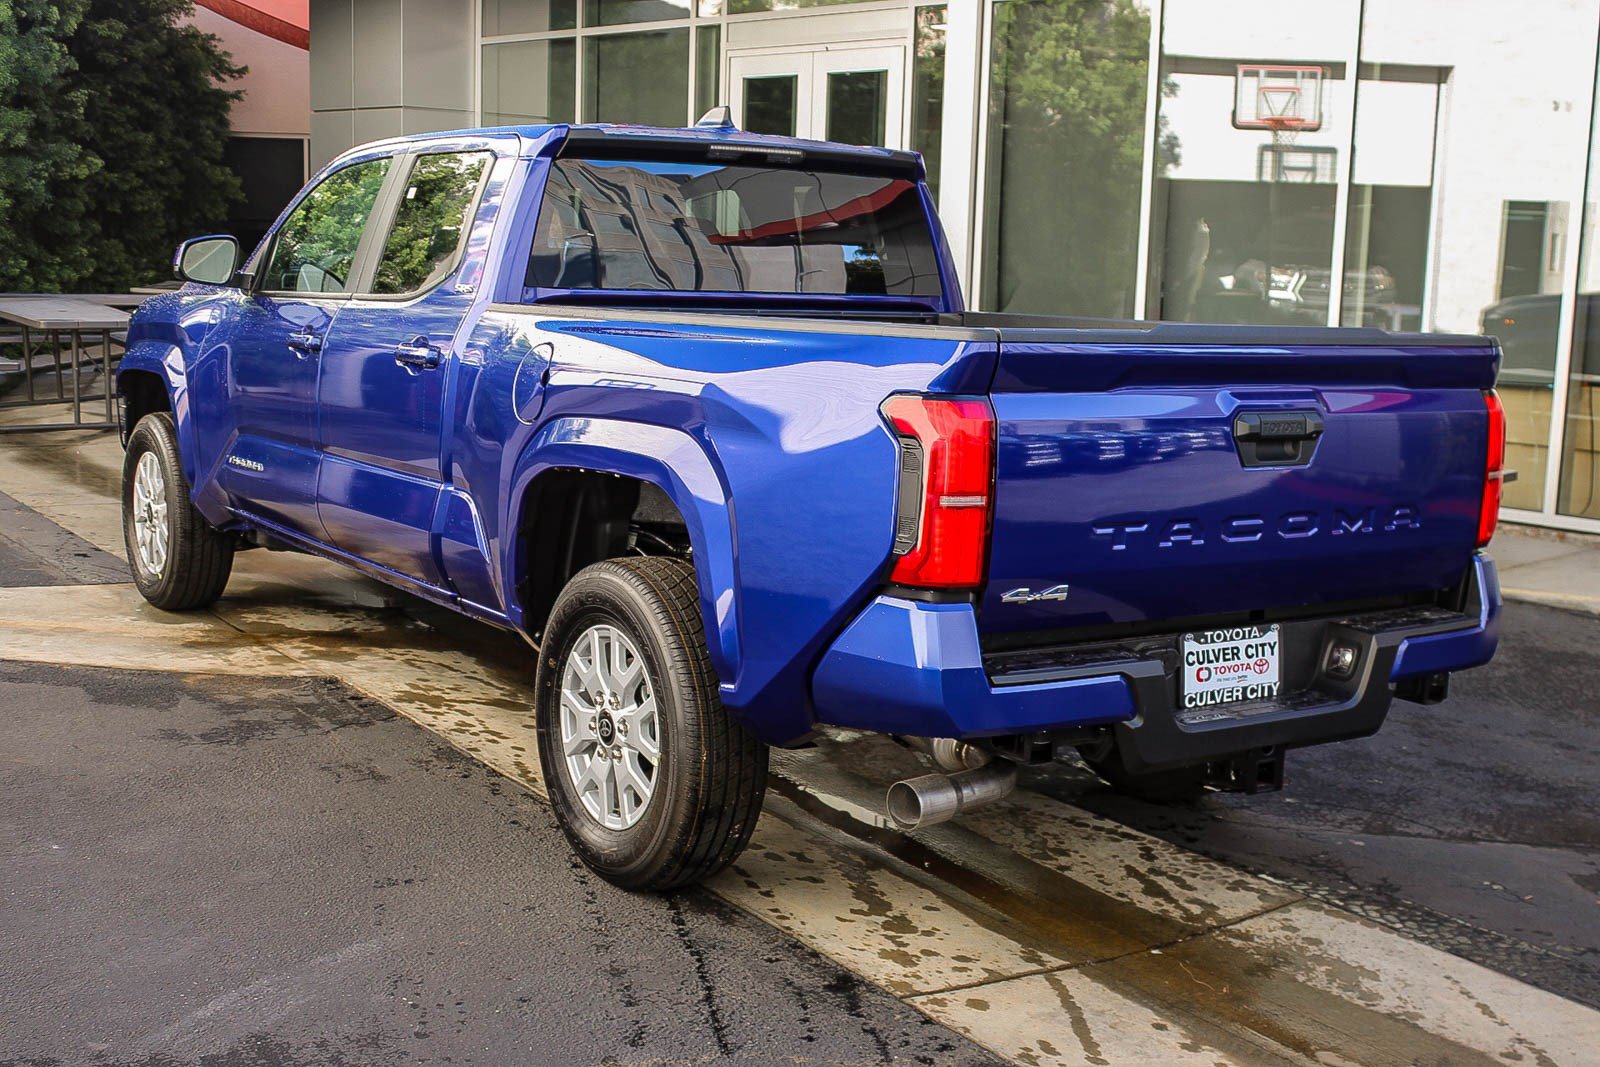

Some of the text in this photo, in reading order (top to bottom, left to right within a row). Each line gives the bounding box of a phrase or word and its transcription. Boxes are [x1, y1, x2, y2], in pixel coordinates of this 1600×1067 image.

[1092, 504, 1421, 550] TACOMA
[1204, 626, 1260, 643] TOYOTA
[1186, 641, 1278, 667] CULVER CITY
[1213, 662, 1252, 675] TOYOTA
[1184, 681, 1280, 708] CULVER CITY
